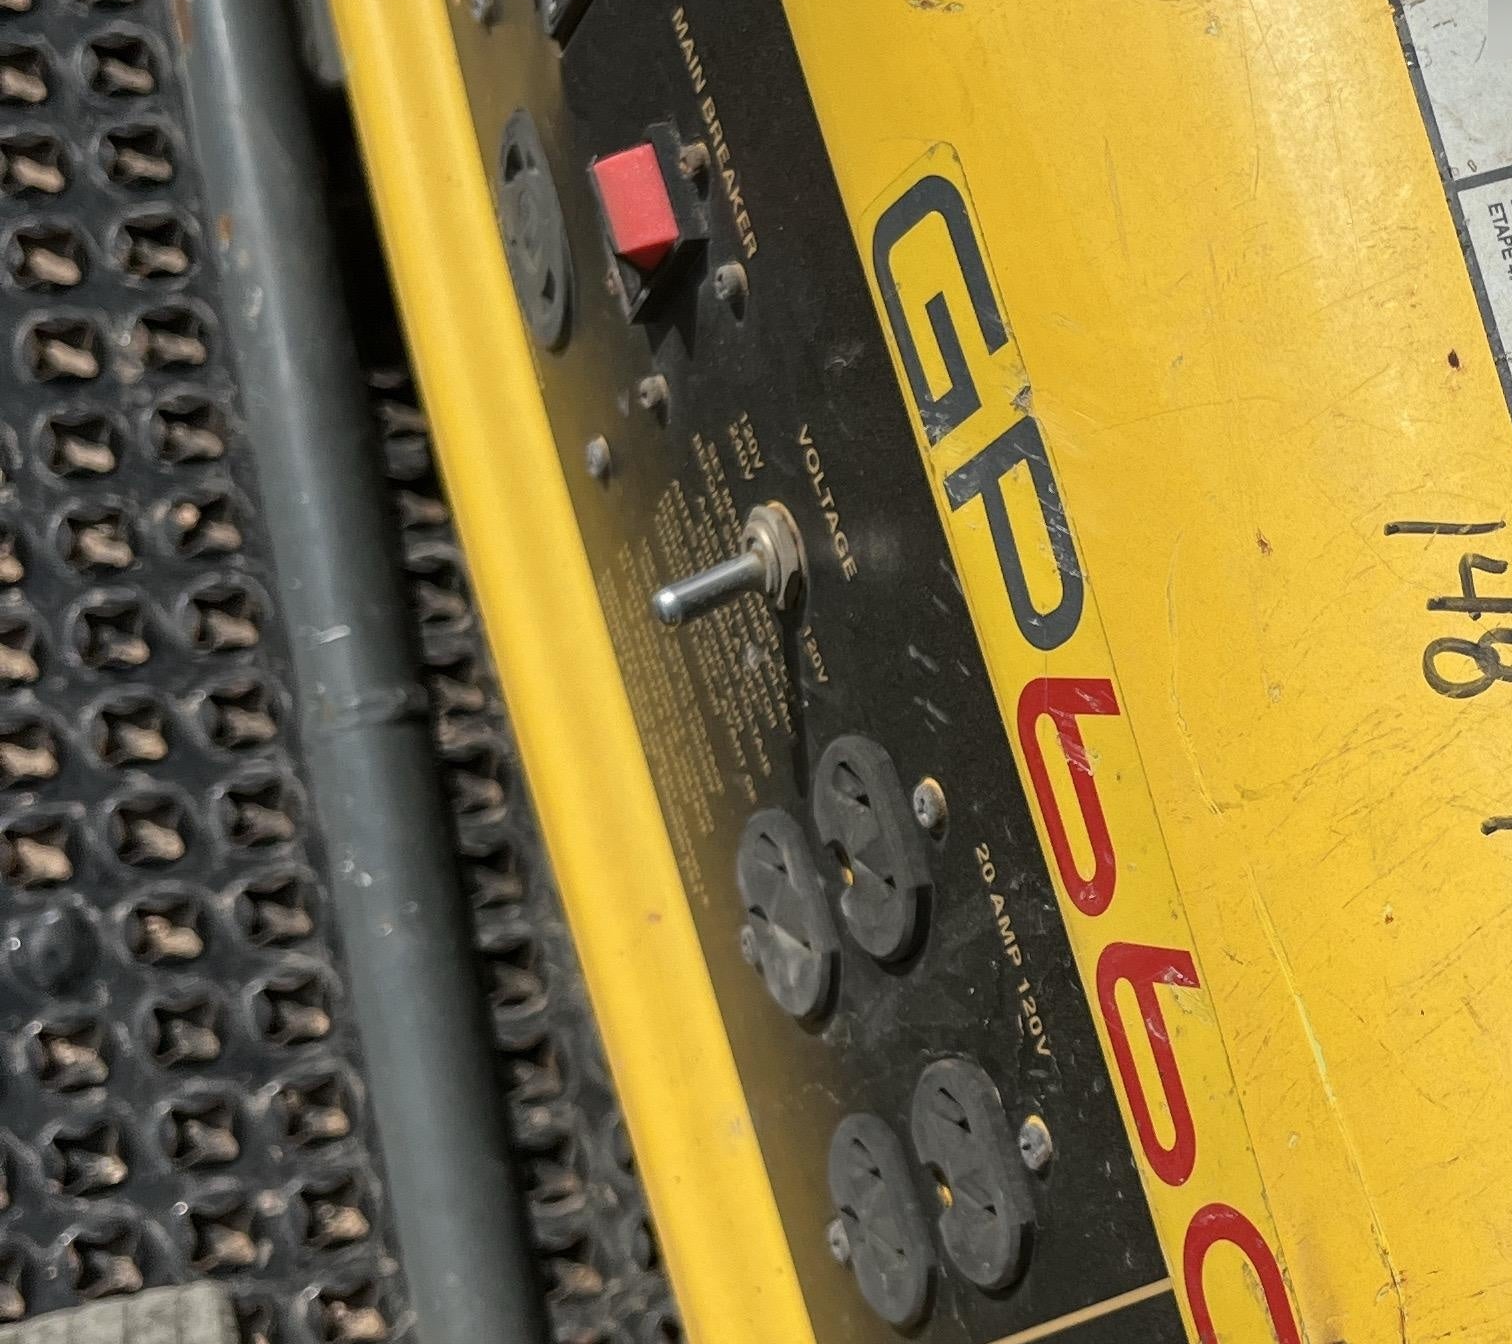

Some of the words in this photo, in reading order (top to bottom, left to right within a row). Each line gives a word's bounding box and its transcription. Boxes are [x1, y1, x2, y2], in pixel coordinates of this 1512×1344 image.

[667, 6, 710, 94] MAIN
[697, 96, 761, 260] BREAKER
[726, 422, 755, 481] 240V
[736, 410, 765, 470] 120V
[794, 423, 859, 582] VOLTAGE
[800, 624, 829, 684] 120V
[973, 842, 997, 882] 20
[988, 890, 1024, 969] AMP
[1014, 977, 1052, 1059] 120V
